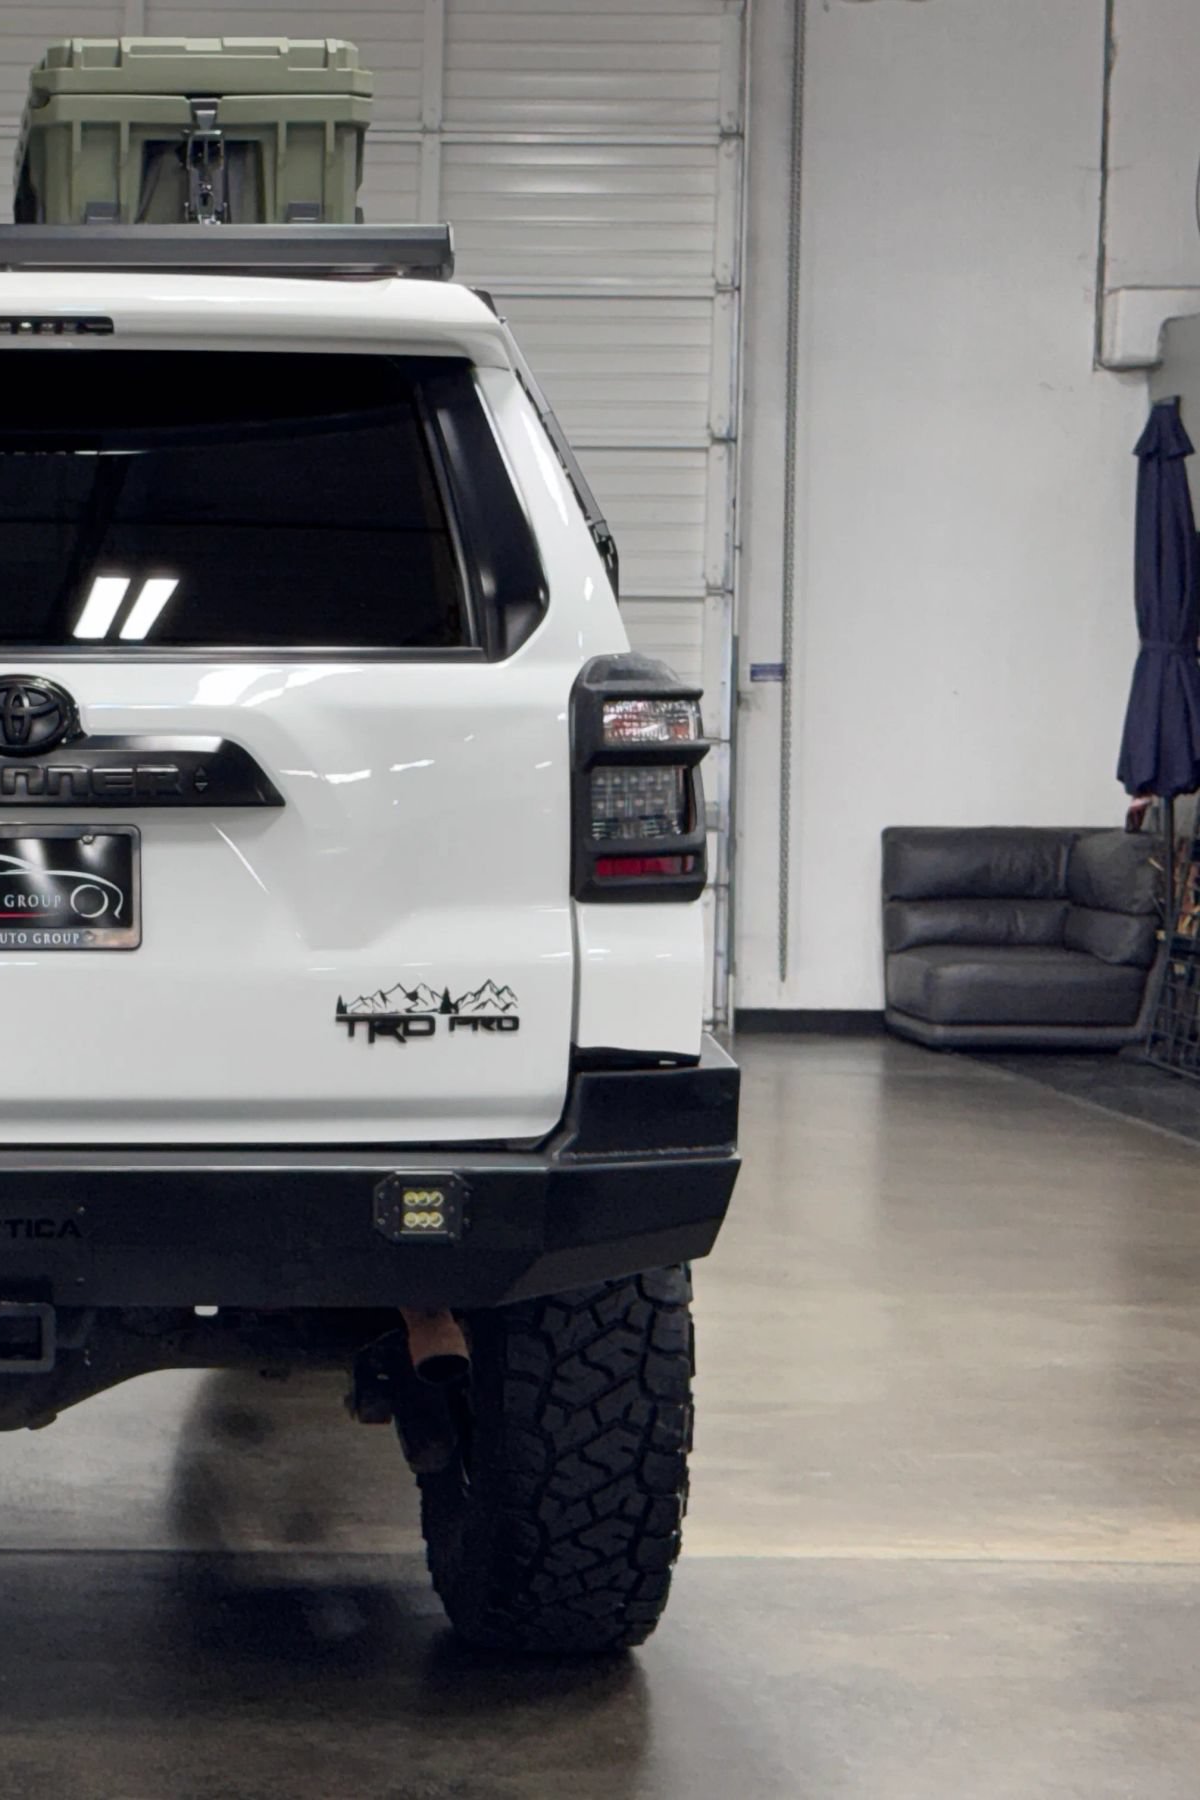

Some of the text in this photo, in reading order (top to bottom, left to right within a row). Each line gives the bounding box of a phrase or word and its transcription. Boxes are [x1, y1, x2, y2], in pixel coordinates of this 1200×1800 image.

[4, 895, 62, 908] GROUP
[32, 932, 81, 944] GROUP
[336, 1015, 520, 1044] TRD PRO
